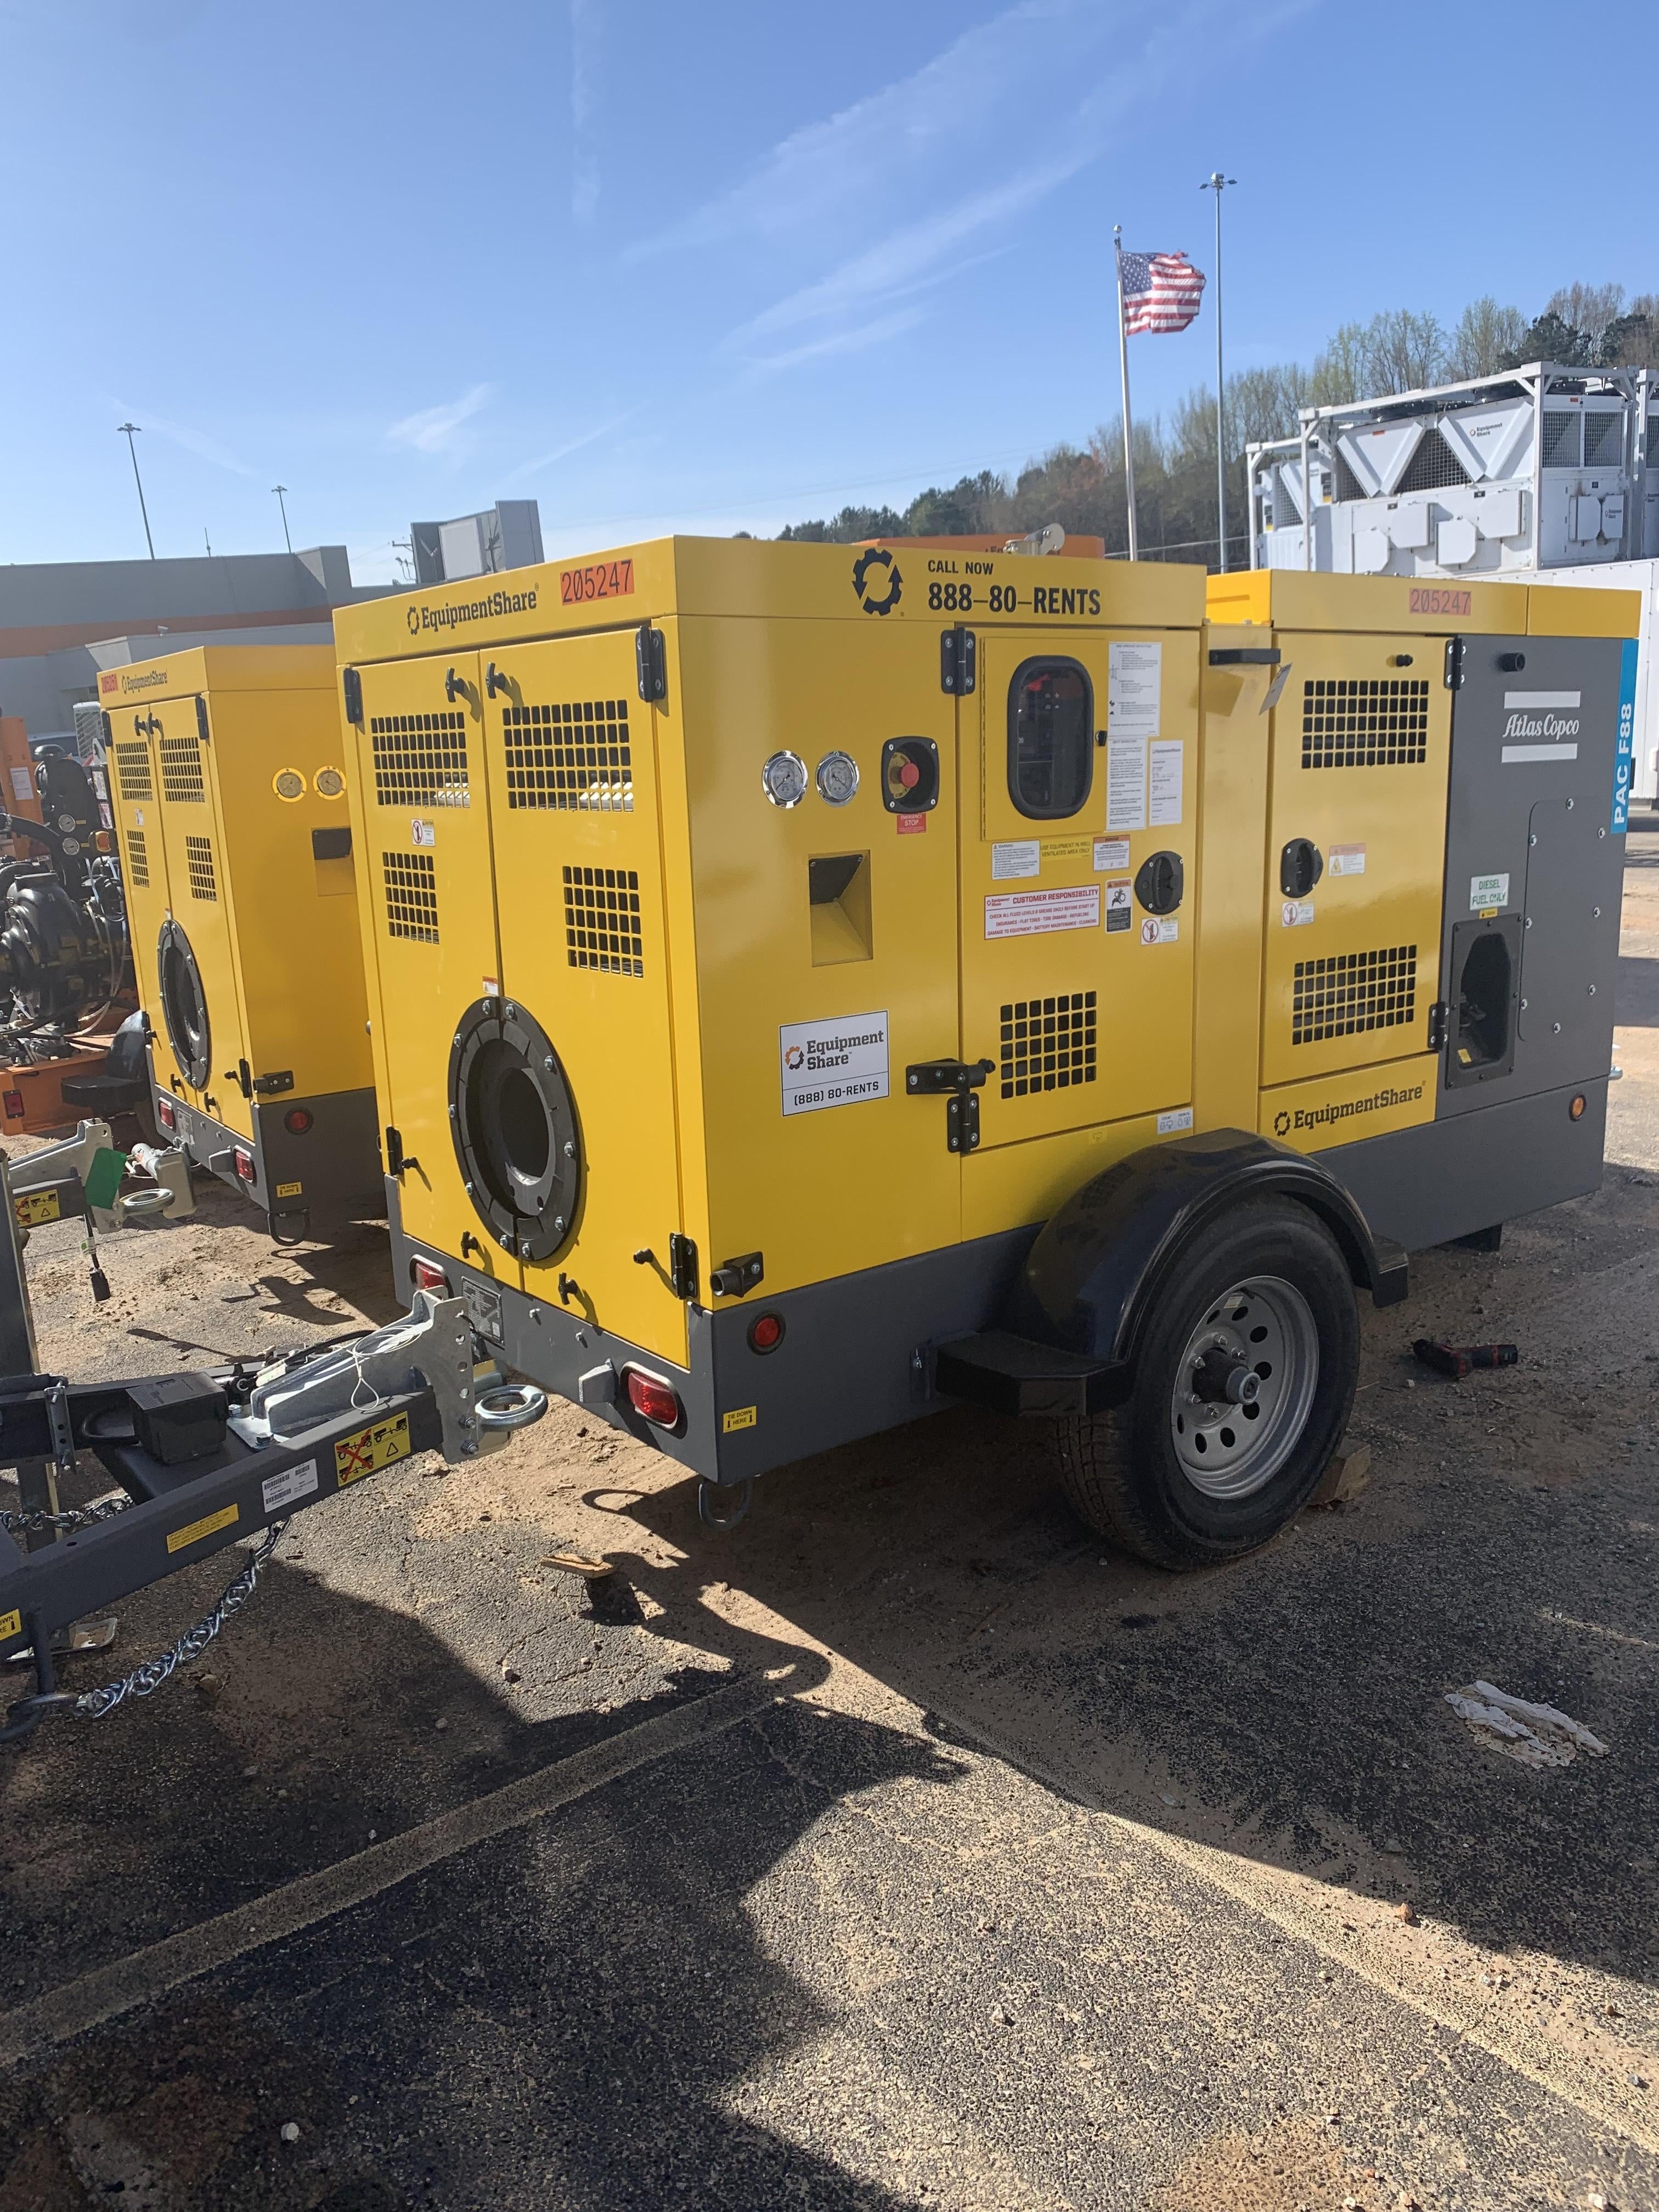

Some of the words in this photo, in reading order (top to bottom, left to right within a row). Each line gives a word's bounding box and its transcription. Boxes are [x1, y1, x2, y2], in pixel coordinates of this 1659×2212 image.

[928, 560, 959, 573] CALL
[966, 562, 994, 575] NOW
[562, 560, 631, 602] 205247
[422, 590, 537, 632] EquipmentShare
[1411, 589, 1470, 614] 205247
[1502, 714, 1542, 738] Atlas
[1543, 714, 1579, 741] Copco
[1618, 703, 1632, 754] F88
[1614, 765, 1628, 824] PAC
[1013, 894, 1047, 904] CUSTOMER
[1048, 889, 1098, 900] RESPONSIBILITY
[1479, 879, 1500, 890] DIESEL
[1472, 894, 1488, 905] FUEL
[1489, 892, 1506, 902] ONLY
[806, 1030, 884, 1055] Equipment
[807, 1054, 849, 1070] Share
[794, 1090, 823, 1106] (888)
[828, 1081, 879, 1099] 80-RENTS
[1294, 1085, 1422, 1129] EquipmentShare
[737, 1409, 752, 1418] DOWN
